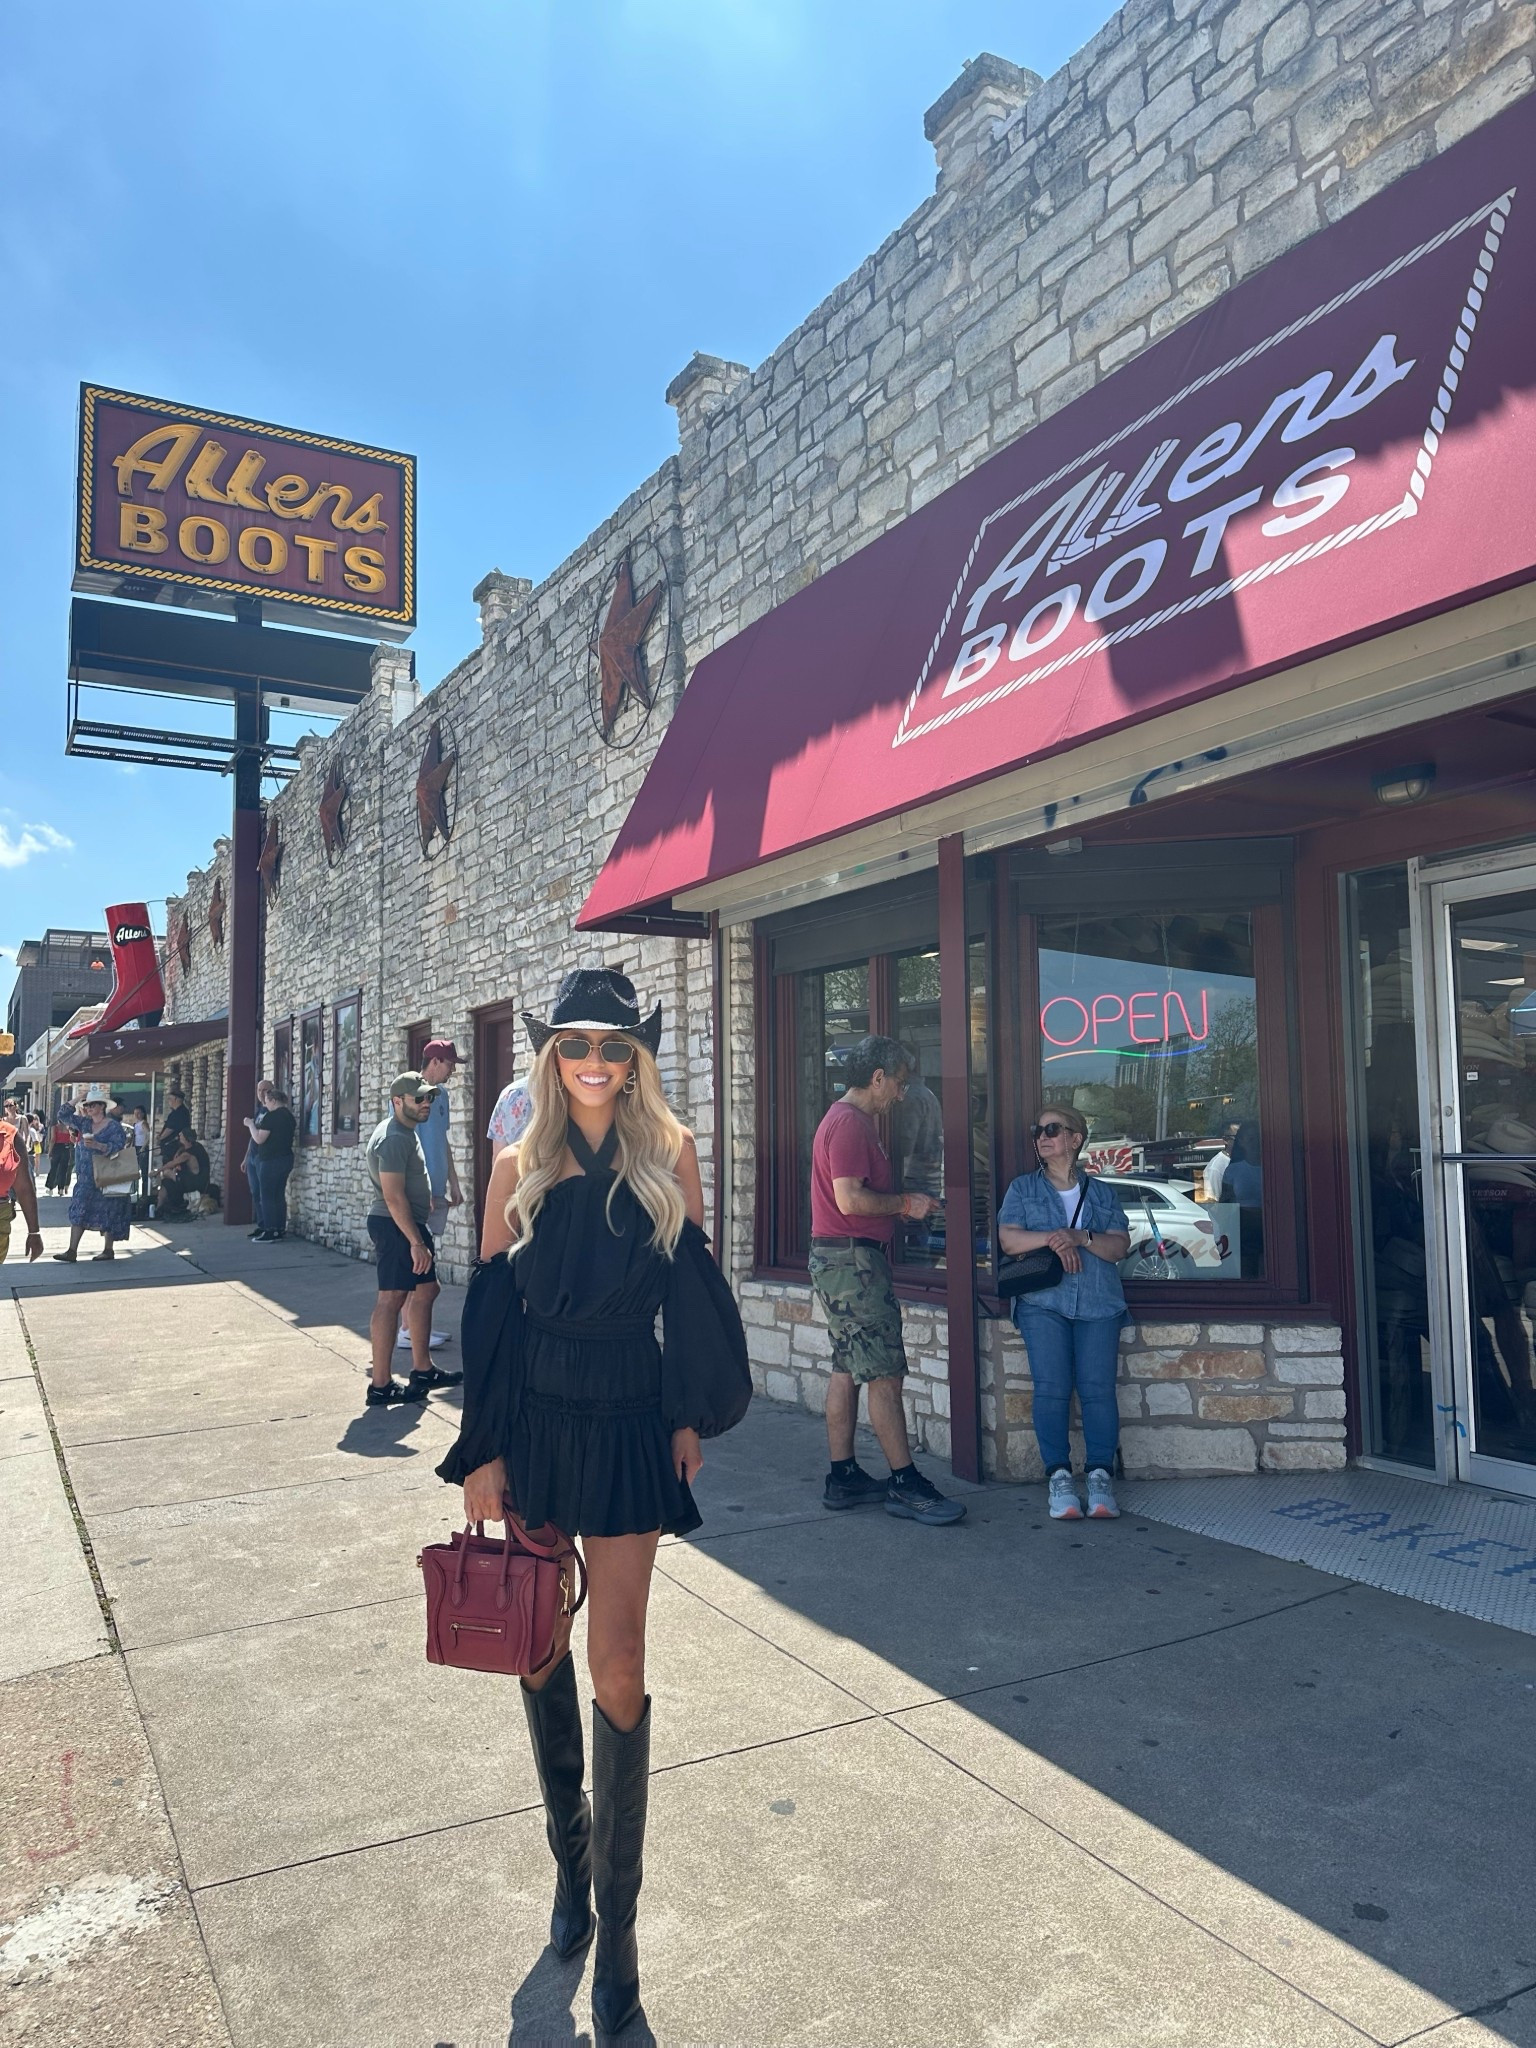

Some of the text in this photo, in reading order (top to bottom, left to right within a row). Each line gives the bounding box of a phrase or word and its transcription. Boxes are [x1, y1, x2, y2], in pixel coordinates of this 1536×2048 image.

[111, 423, 389, 535] Allens
[960, 334, 1416, 635] Allens
[119, 502, 387, 594] BOOTS
[942, 447, 1356, 700] BOOTS
[115, 927, 148, 942] Allens
[1040, 989, 1209, 1046] OPEN
